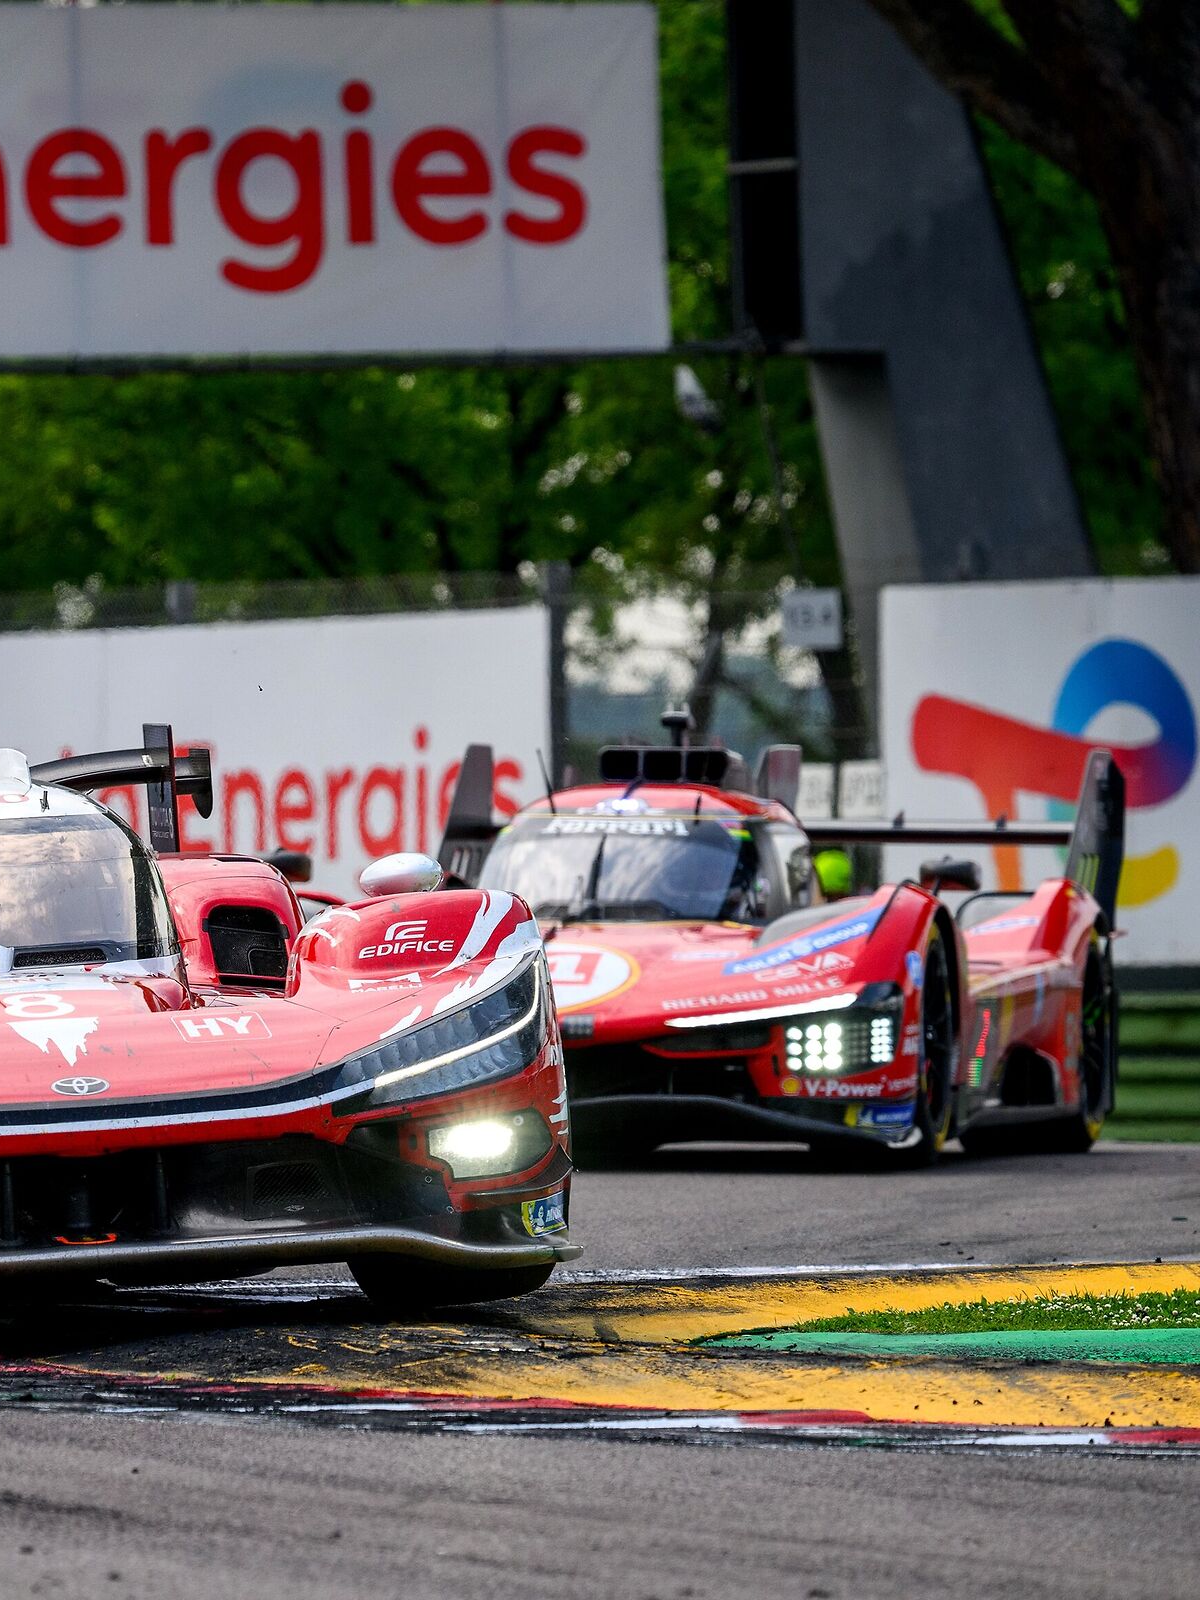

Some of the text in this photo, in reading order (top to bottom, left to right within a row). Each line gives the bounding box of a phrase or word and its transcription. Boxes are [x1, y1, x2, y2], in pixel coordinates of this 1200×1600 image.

[540, 818, 690, 837] Ferrari
[358, 940, 455, 959] EDIFICE
[661, 976, 844, 1011] RICHARD MILLE
[4, 993, 76, 1019] 8
[181, 1015, 252, 1039] HY
